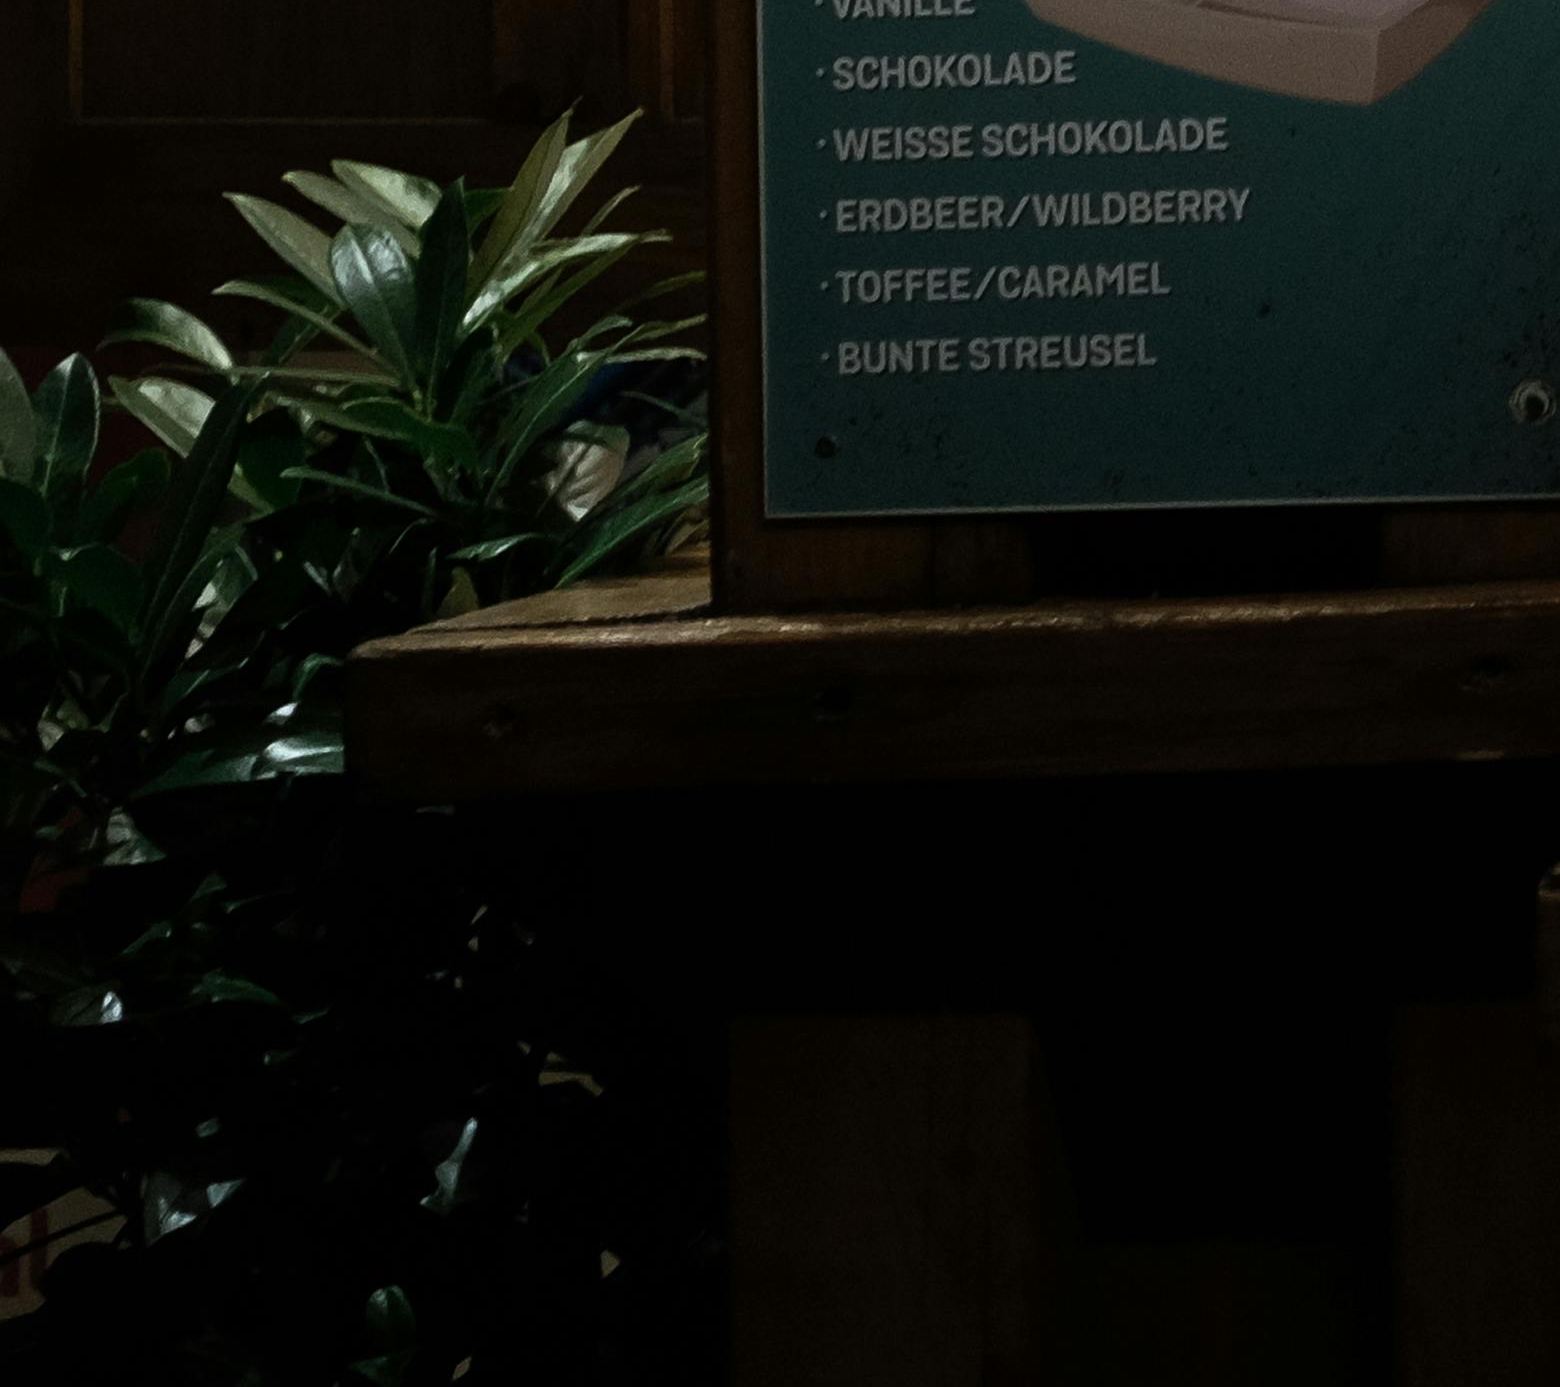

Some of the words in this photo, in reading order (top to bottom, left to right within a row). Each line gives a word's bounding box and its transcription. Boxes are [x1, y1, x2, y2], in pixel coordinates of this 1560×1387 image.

[832, 50, 1077, 91] SCHOKOLADE
[833, 126, 973, 161] WEISSE
[981, 117, 1229, 158] SCHOKOLADE
[836, 187, 1250, 233] ERDBEER/WILDBERRY
[835, 261, 1172, 304] TOFFEE/CARAMEL
[838, 337, 960, 375] BUNTE
[968, 333, 1157, 370] STREUSEL
